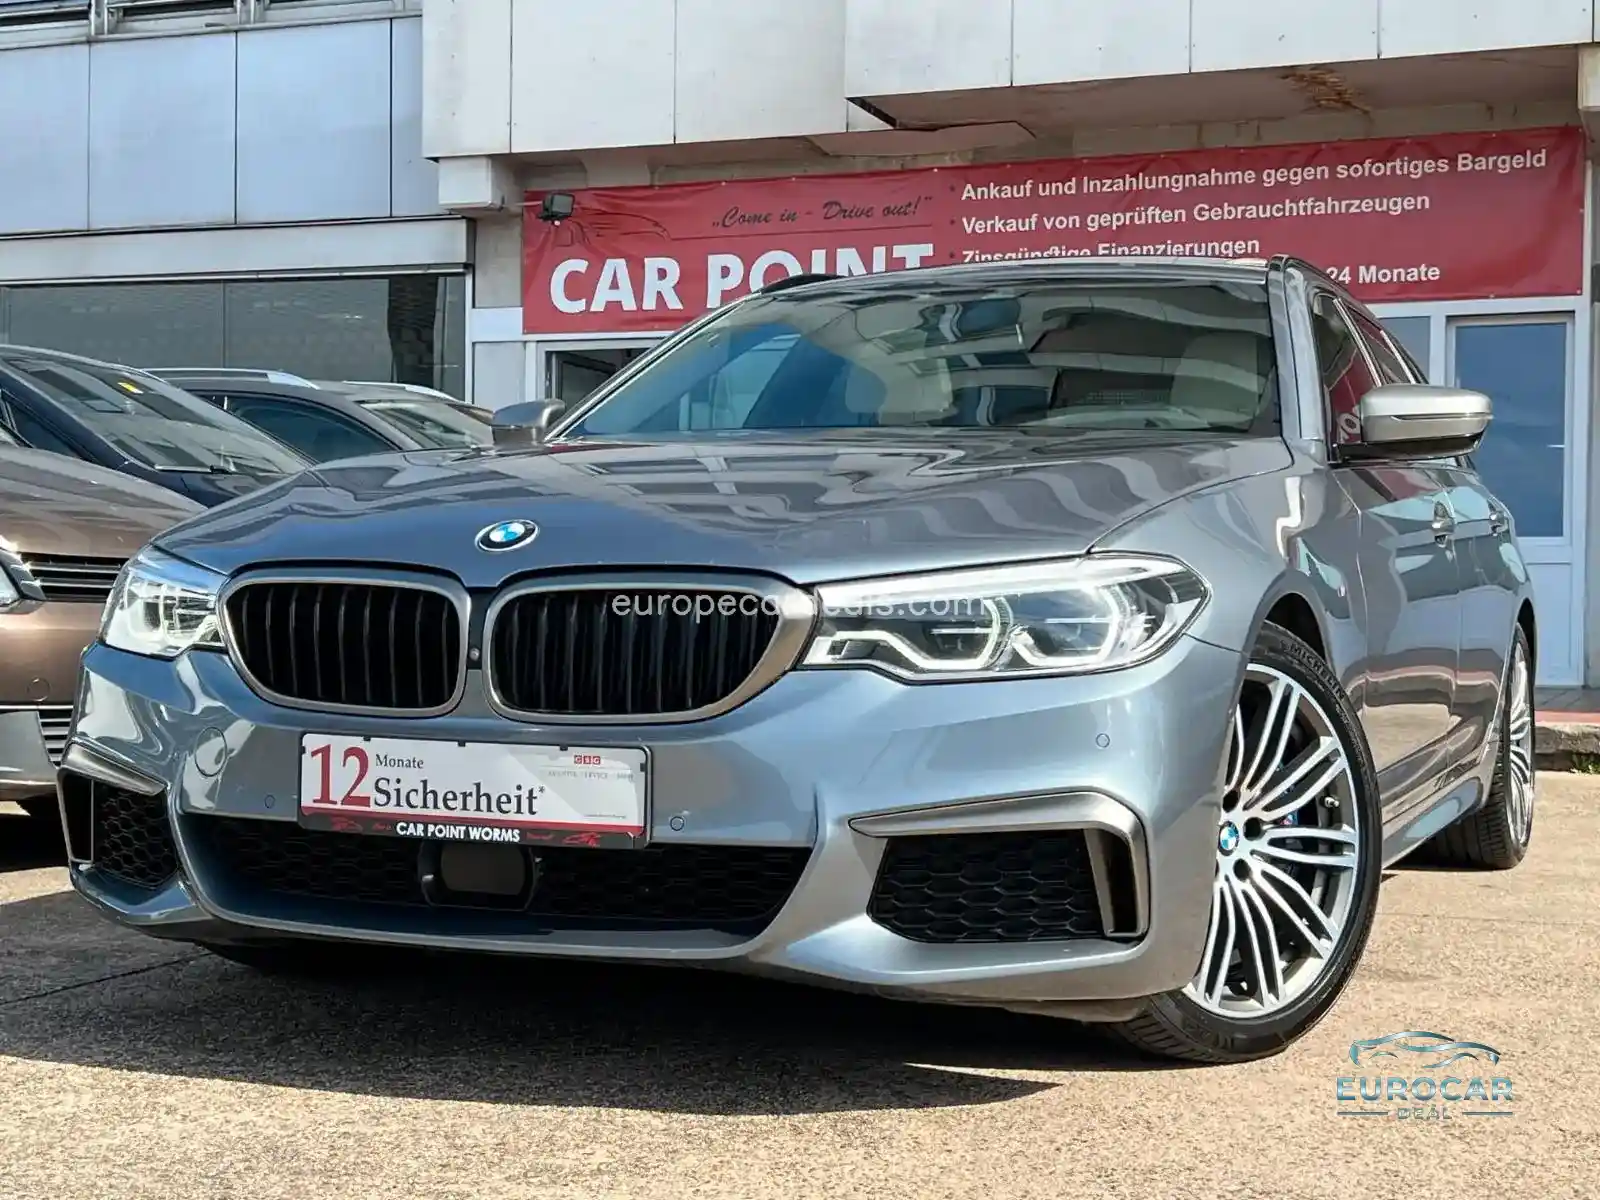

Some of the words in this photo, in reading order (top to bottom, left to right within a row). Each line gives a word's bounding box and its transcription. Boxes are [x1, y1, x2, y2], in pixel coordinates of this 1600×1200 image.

[961, 180, 1034, 200] Ankauf
[1038, 177, 1076, 196] und
[1083, 168, 1256, 193] Inzahlungnahme
[1262, 164, 1329, 187] gegen
[1336, 157, 1449, 179] sofortiges
[1457, 149, 1547, 173] Bargeld
[779, 208, 798, 222] in
[823, 200, 875, 220] Drive
[962, 214, 1039, 234] Verkauf
[1043, 214, 1080, 230] von
[1087, 206, 1186, 231] geprüften
[1193, 194, 1431, 223] Gebrauchtfahrzeugen
[1098, 239, 1260, 257] Finanzierungen
[1358, 263, 1441, 284] Monate
[550, 257, 684, 313] CAR
[375, 753, 424, 769] Monate
[311, 743, 371, 808] 12
[396, 822, 425, 837] CAR
[427, 824, 467, 840] POINT
[468, 826, 520, 842] WORMS
